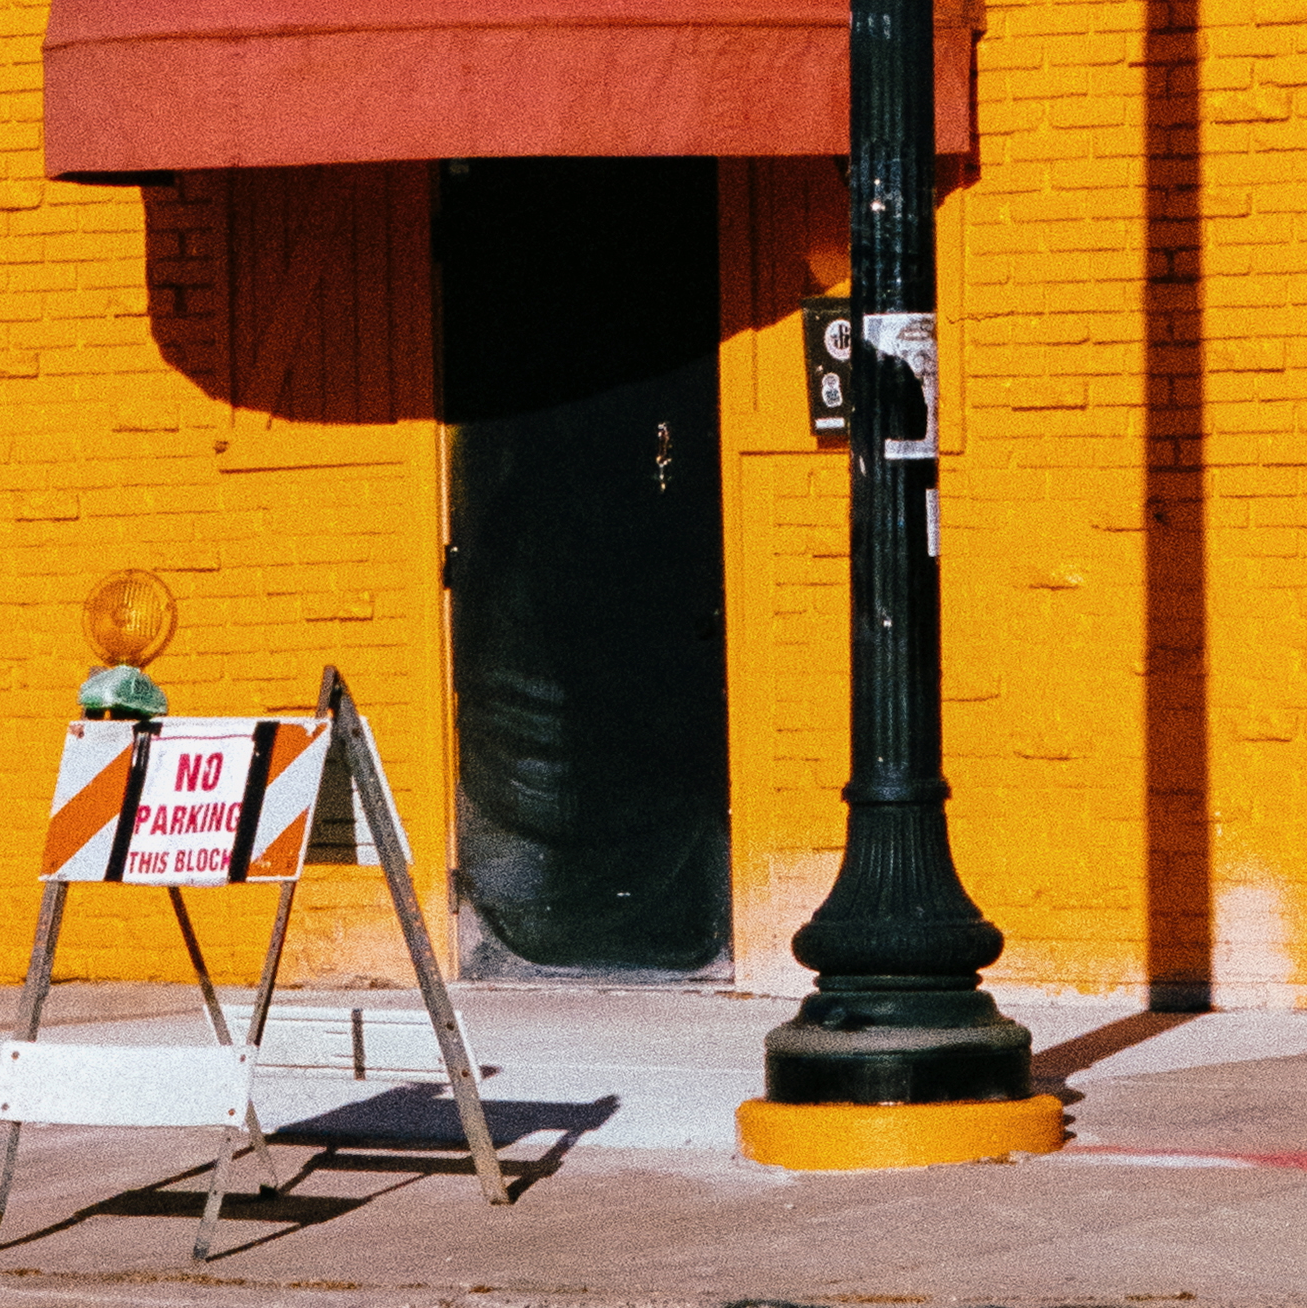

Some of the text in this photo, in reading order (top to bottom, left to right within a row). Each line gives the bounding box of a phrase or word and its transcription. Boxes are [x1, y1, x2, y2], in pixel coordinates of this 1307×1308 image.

[174, 752, 224, 792] NO
[134, 801, 244, 836] PARKING
[129, 851, 170, 874] THIS
